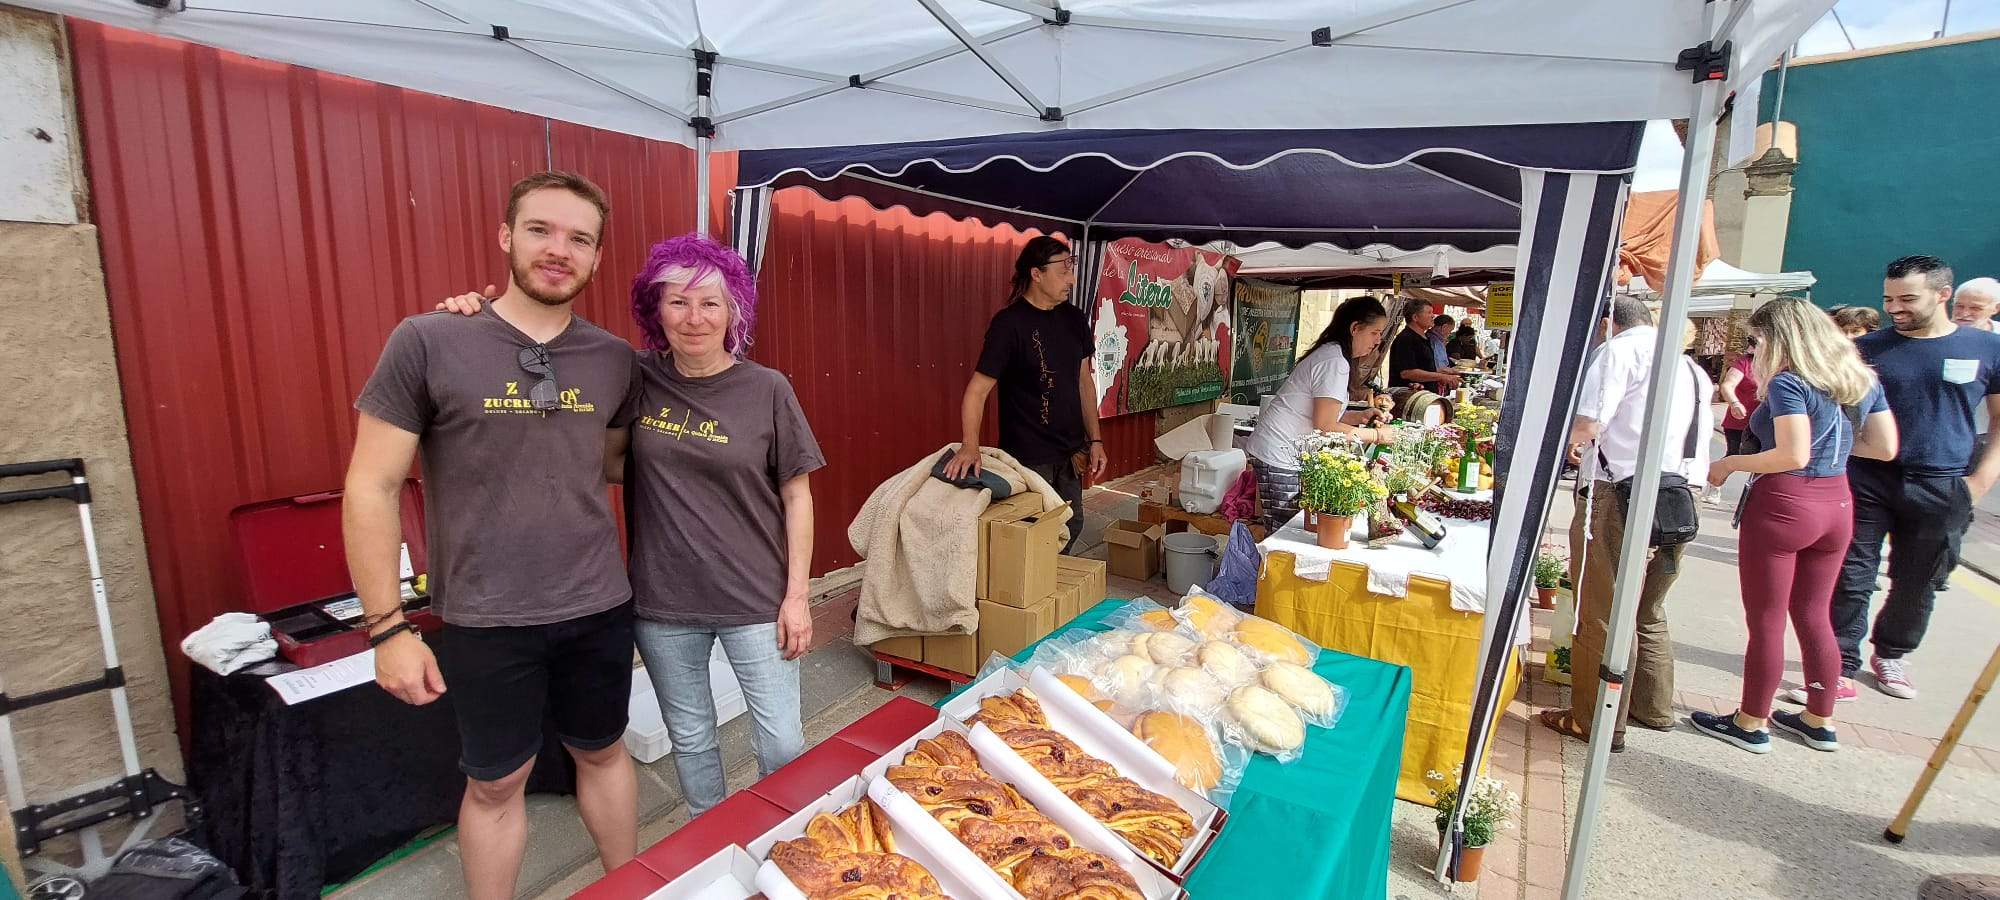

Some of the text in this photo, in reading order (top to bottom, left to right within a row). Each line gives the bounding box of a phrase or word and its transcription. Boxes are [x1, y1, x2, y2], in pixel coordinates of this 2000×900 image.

[1103, 259, 1116, 277] de
[1119, 259, 1173, 309] Litera
[506, 381, 518, 396] Z
[483, 398, 540, 408] ZUCRE
[659, 407, 671, 418] Z
